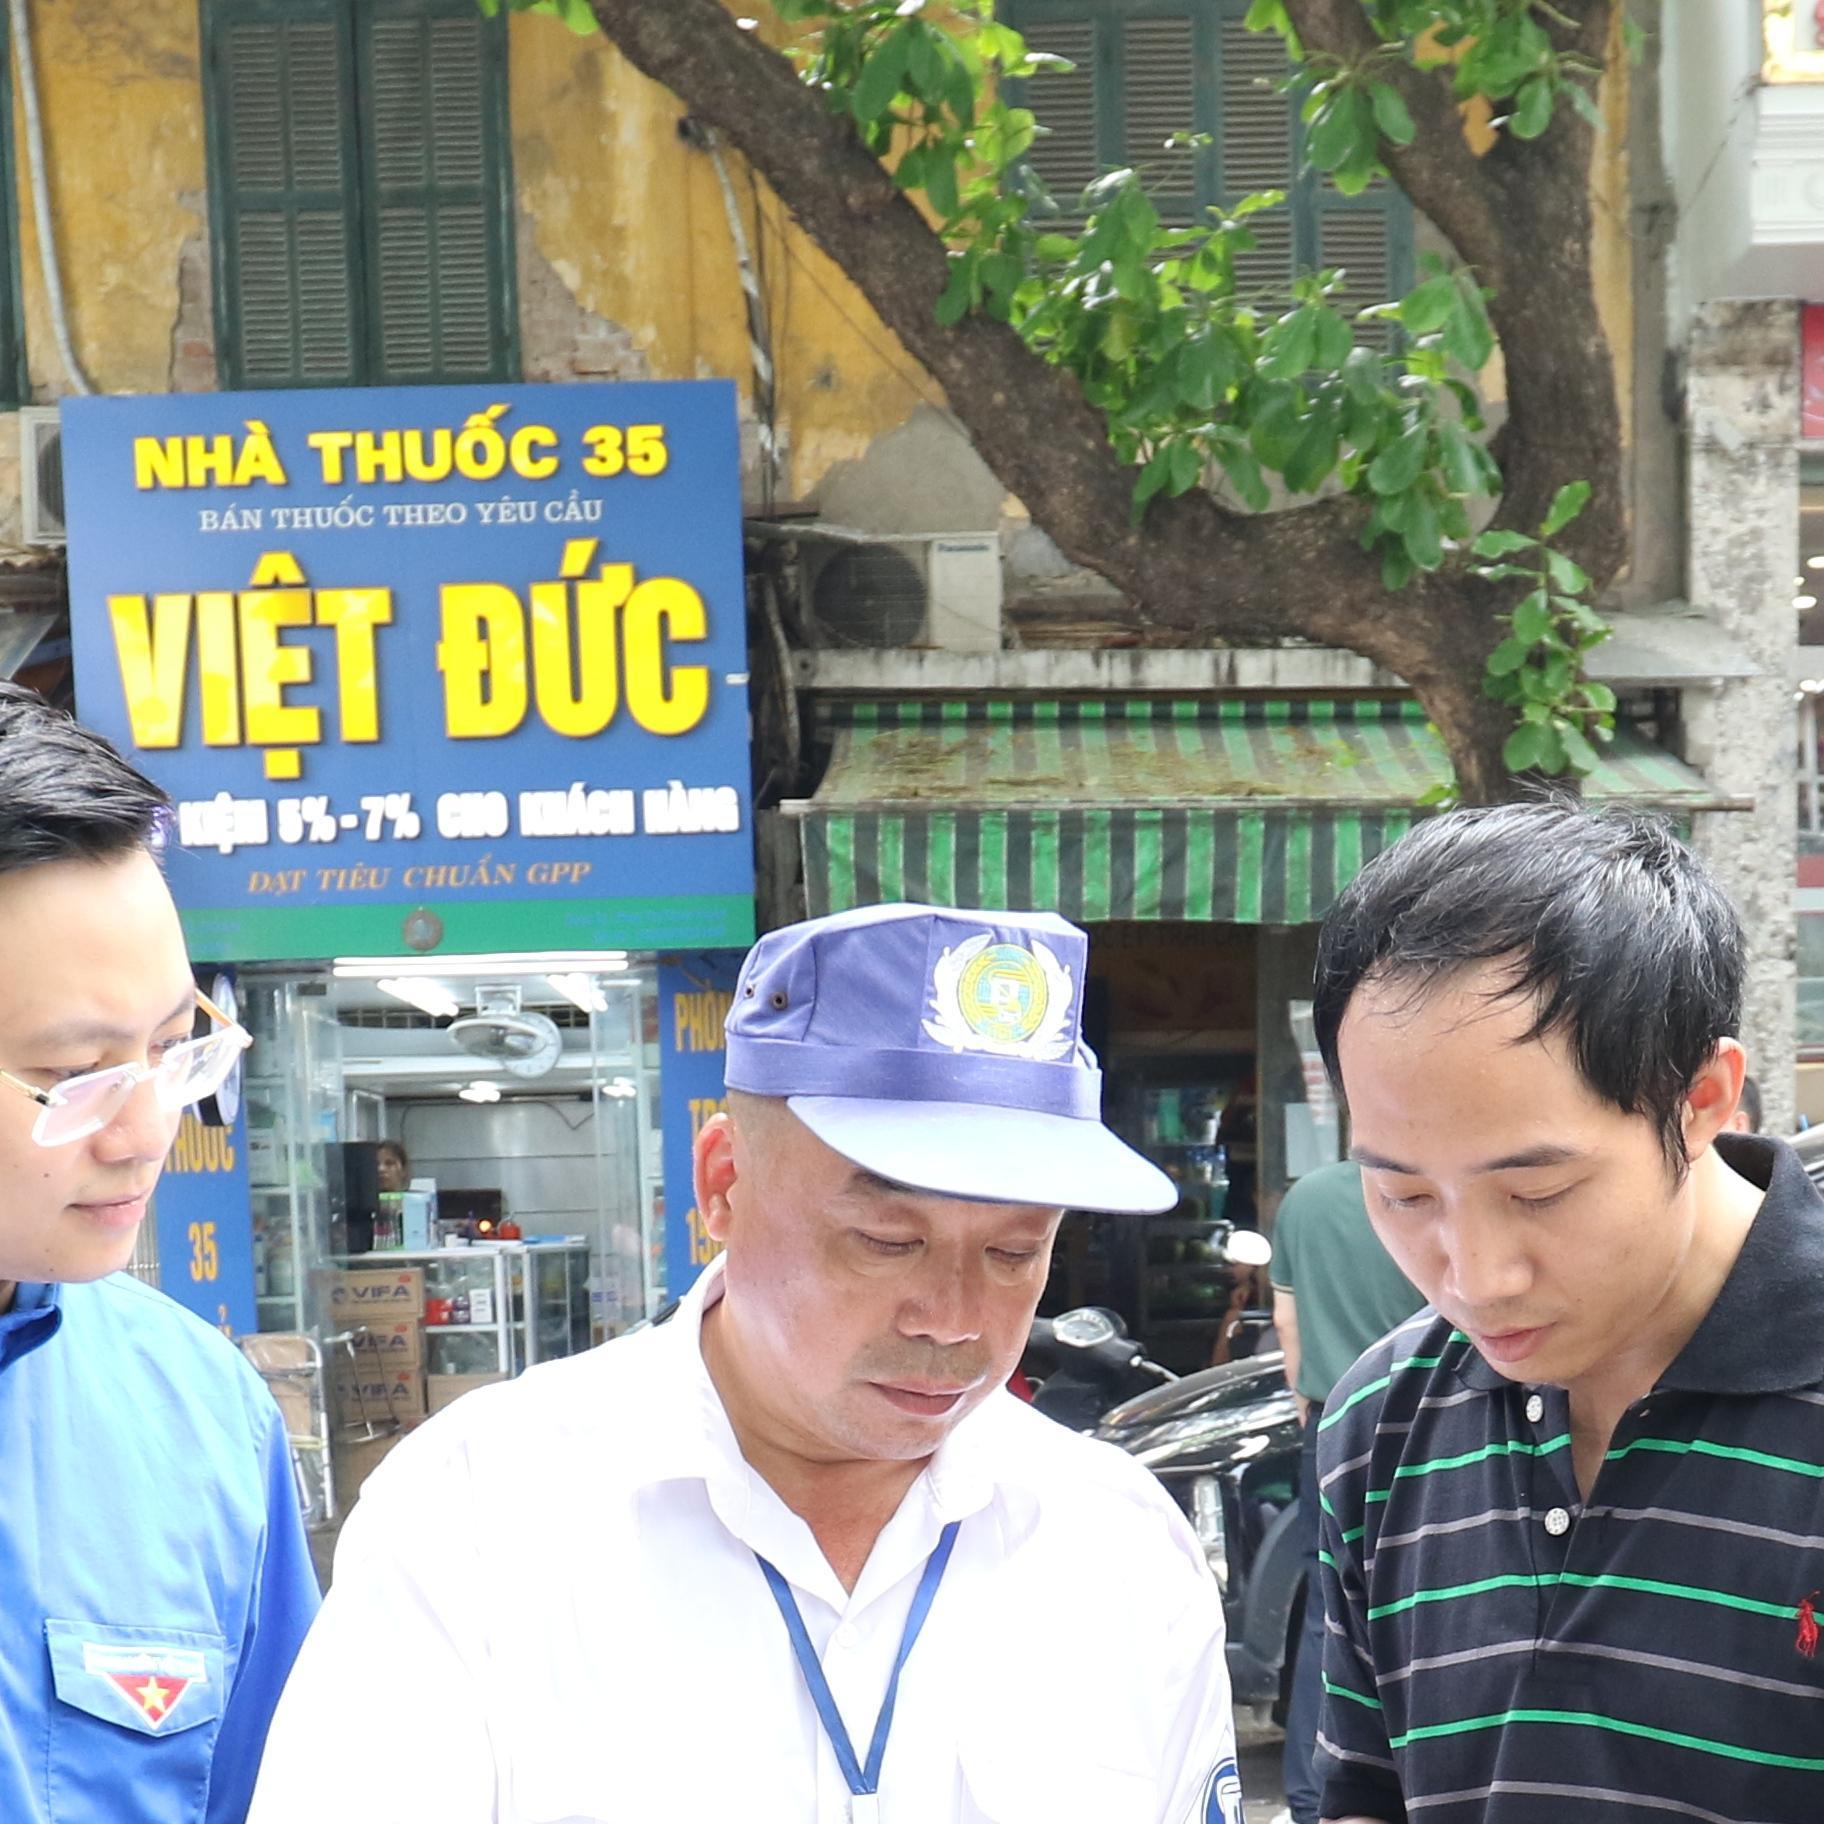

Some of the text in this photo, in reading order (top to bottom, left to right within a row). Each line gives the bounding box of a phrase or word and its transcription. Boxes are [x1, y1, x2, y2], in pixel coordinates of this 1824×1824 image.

[134, 403, 669, 490] NHÀ THUỐC 35
[198, 488, 604, 533] BÁN THUỐC THEO YÊU CẦU
[107, 538, 711, 780] VIỆT ĐỨC
[643, 779, 741, 835] HÀNG
[247, 868, 307, 894] ĐẠT
[316, 860, 391, 891] TIÊU
[526, 862, 593, 885] GPP
[188, 1221, 219, 1283] 35
[351, 1284, 411, 1299] VIFA
[352, 1334, 407, 1348] VIFA
[351, 1382, 409, 1396] VIFA
